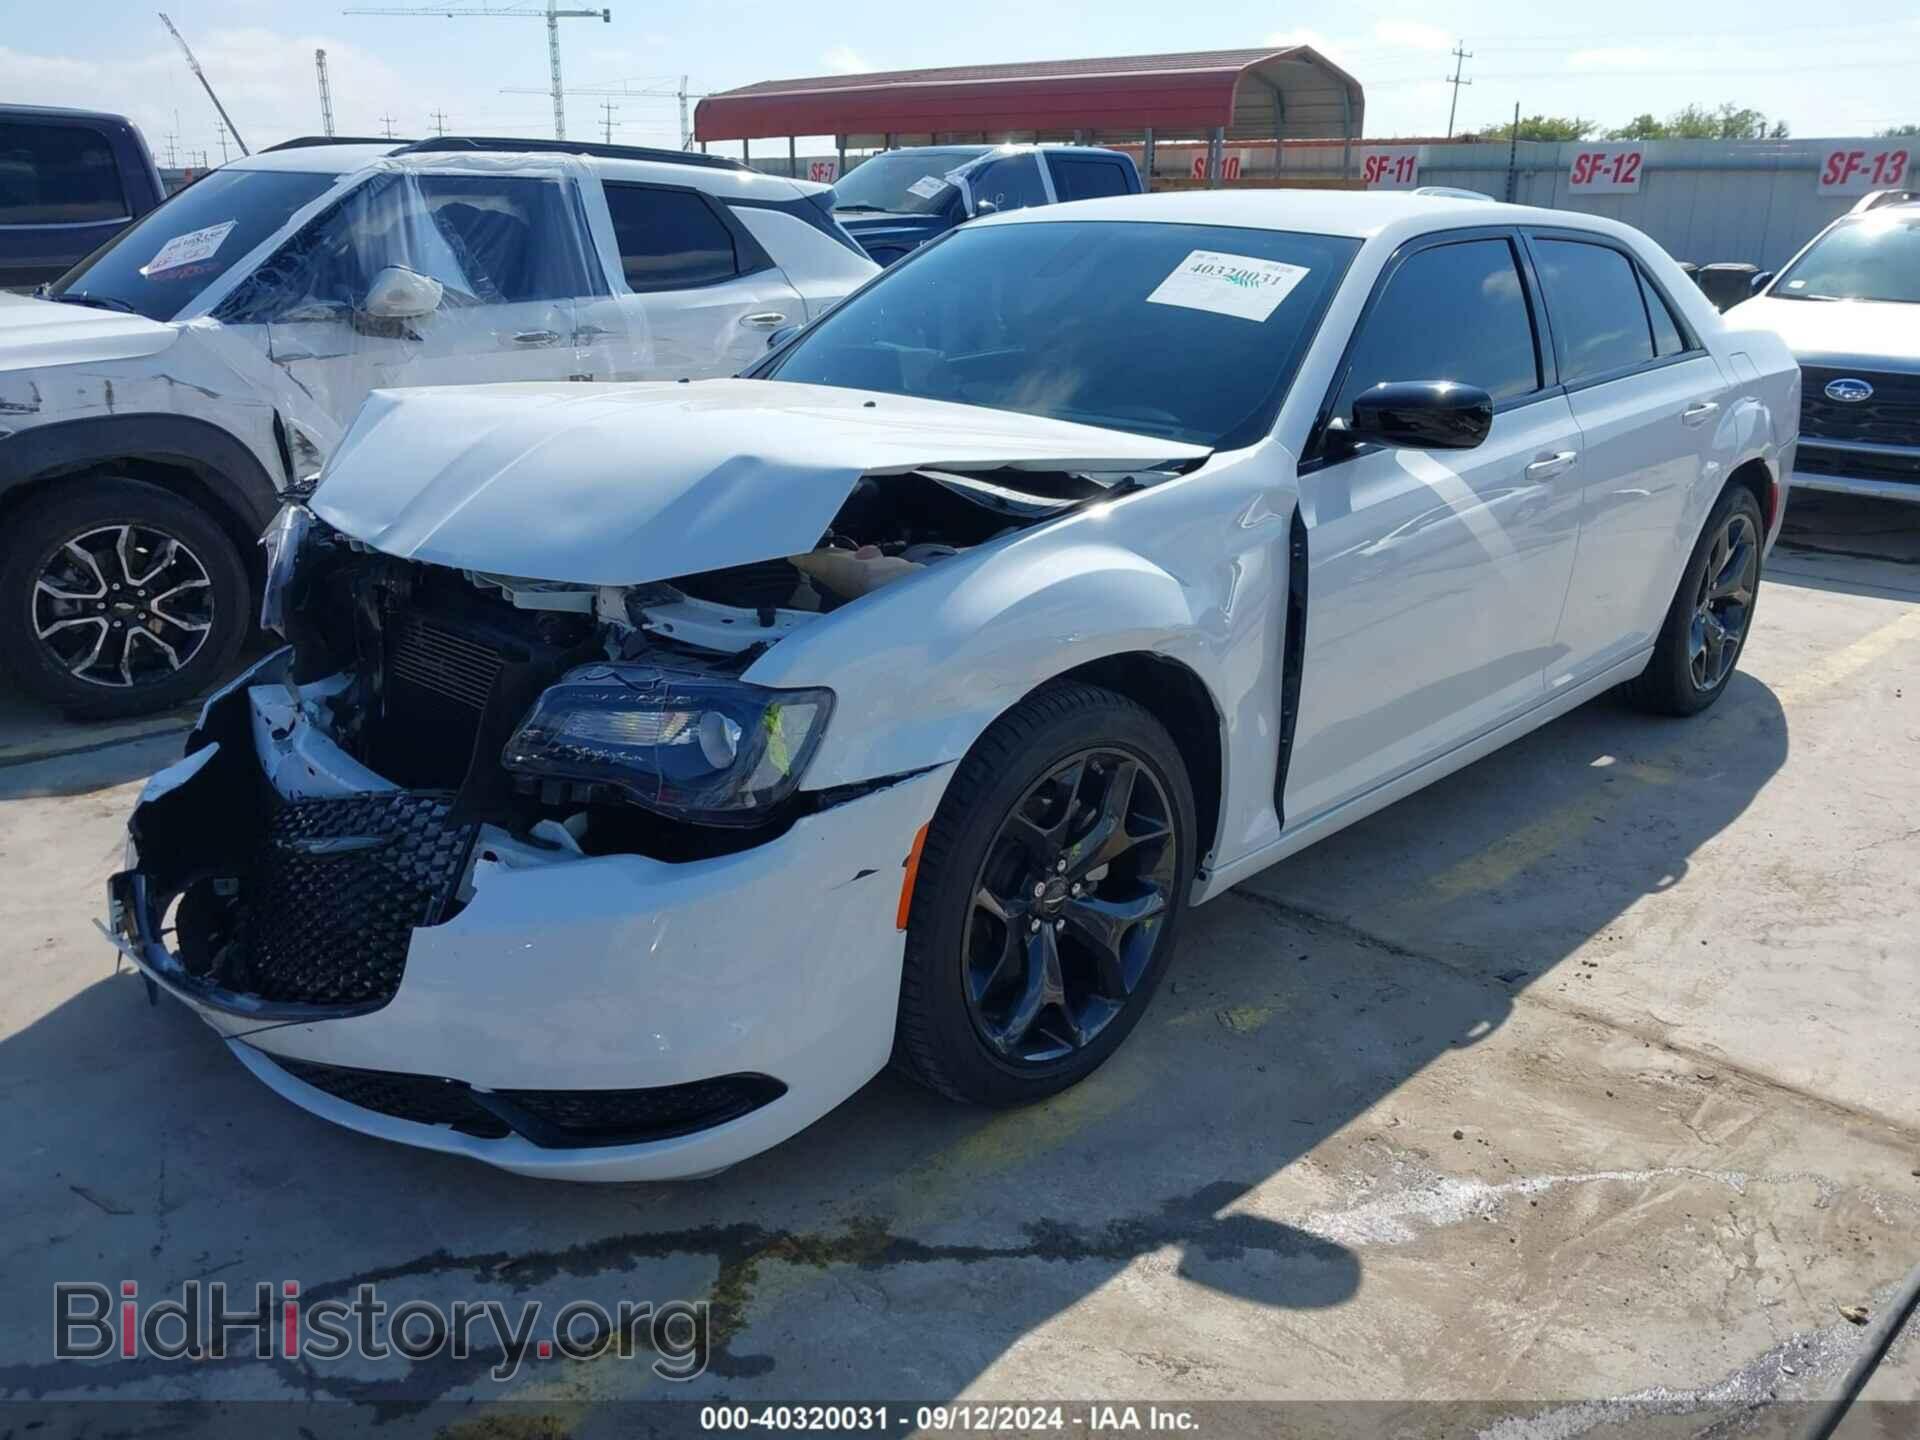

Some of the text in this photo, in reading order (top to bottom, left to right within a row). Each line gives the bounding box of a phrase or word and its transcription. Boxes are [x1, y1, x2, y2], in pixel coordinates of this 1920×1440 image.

[1193, 157, 1240, 180] S10
[1363, 156, 1415, 183] SF-11
[1571, 153, 1640, 184] SF-12
[1822, 150, 1908, 185] SF-13
[1190, 263, 1282, 286] 40320031
